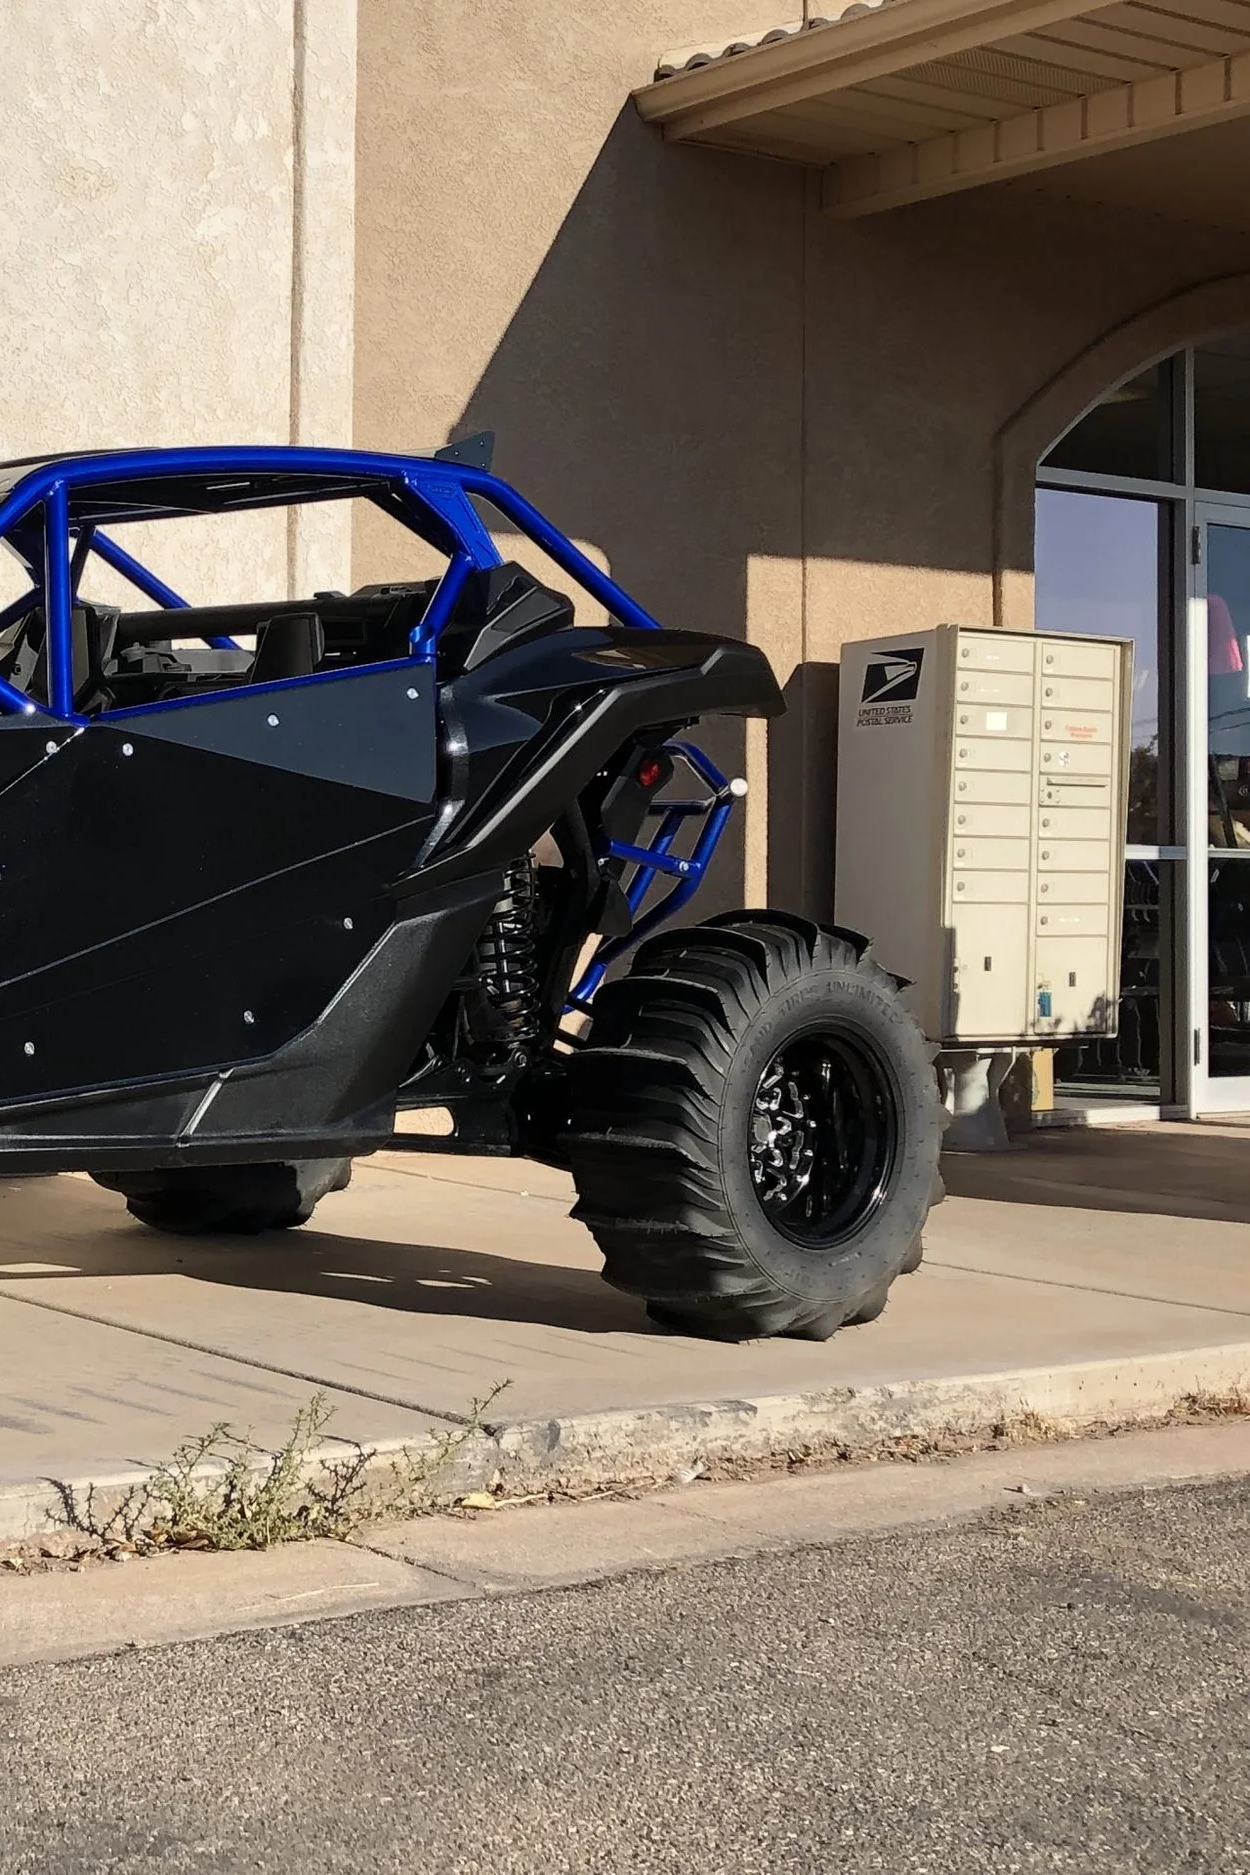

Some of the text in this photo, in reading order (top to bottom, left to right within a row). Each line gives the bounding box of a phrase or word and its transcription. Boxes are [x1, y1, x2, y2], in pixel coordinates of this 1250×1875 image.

[858, 705, 911, 717] UNITED STATES
[856, 715, 913, 727] POSTAL SERVICE
